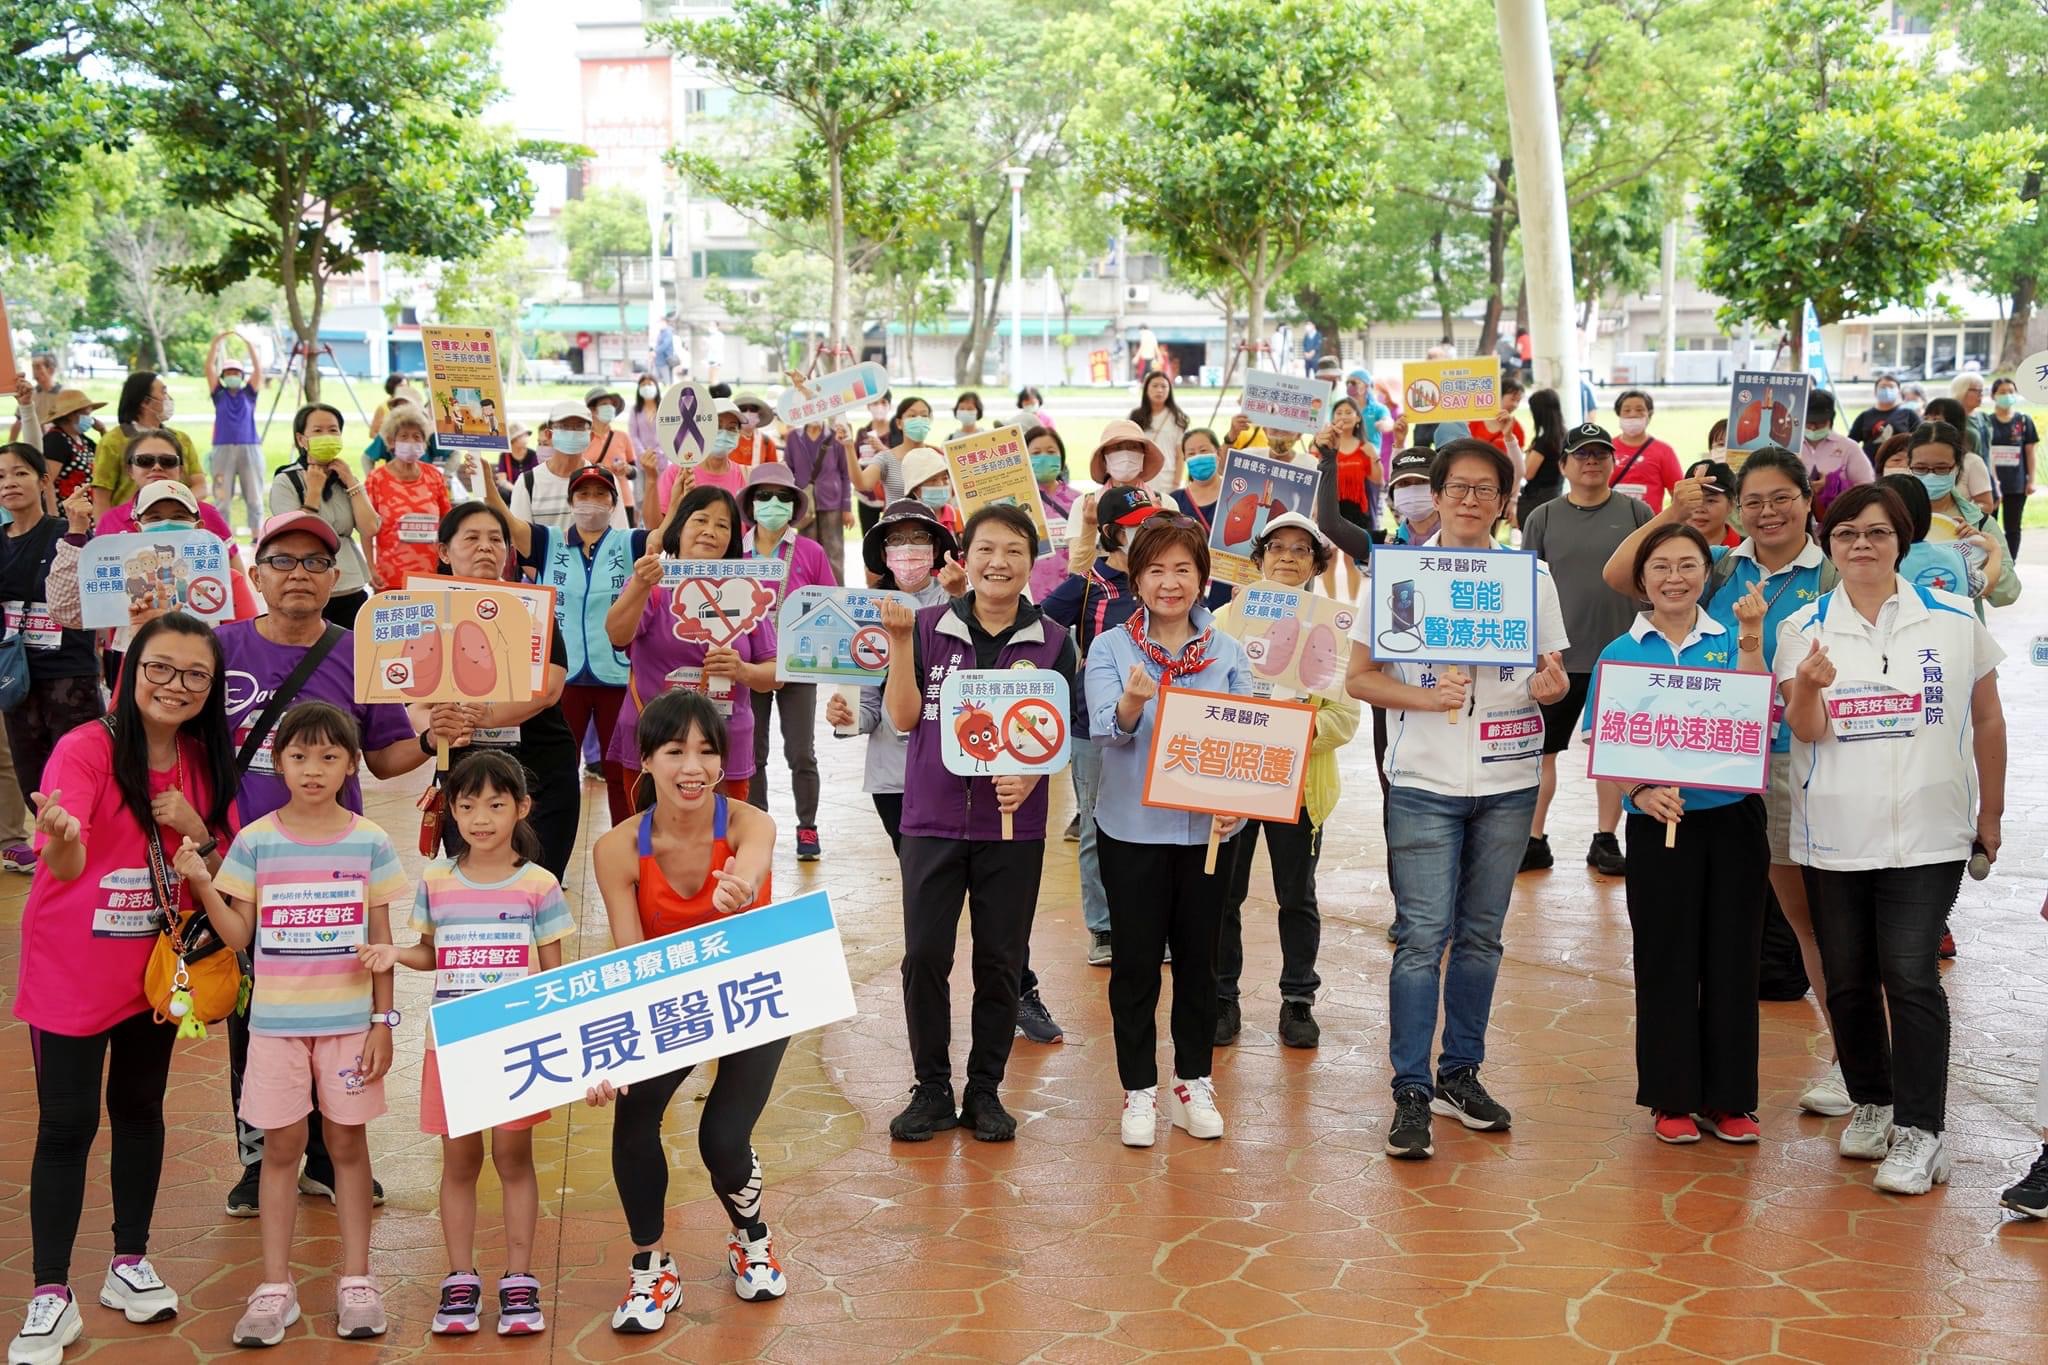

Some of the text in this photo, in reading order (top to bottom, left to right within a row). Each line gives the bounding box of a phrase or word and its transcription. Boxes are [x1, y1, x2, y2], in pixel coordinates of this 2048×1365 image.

[431, 340, 489, 352] 守護家人健康
[1443, 378, 1493, 392] 向電子煙
[1443, 393, 1494, 408] SAY NO
[956, 441, 1019, 465] 守護家人健康
[183, 544, 221, 556] 無菸檳
[96, 566, 122, 579] 健康
[194, 558, 221, 570] 家庭
[722, 564, 782, 576] 拒吸二手菸
[1419, 557, 1487, 573] 天晟醫院
[86, 580, 125, 593] 相伴隨
[1450, 579, 1502, 611] 智能
[1248, 590, 1298, 606] 無菸呼吸
[375, 604, 435, 623] 無菸呼吸
[1424, 616, 1528, 650] 醫療共照
[1648, 673, 1722, 693] 天晟醫院
[1917, 649, 1944, 725] 天晟醫院
[1838, 698, 1914, 715] 齡活好智在
[1204, 705, 1270, 728] 天晟醫院
[1488, 720, 1539, 738] 齡活好智在
[1600, 709, 1762, 754] 綠色快速通道
[1163, 734, 1296, 786] 失智照護
[271, 907, 355, 925] 齡活好智在
[444, 949, 521, 966] 齡活好智在
[504, 971, 790, 1101] 天晟醫院
